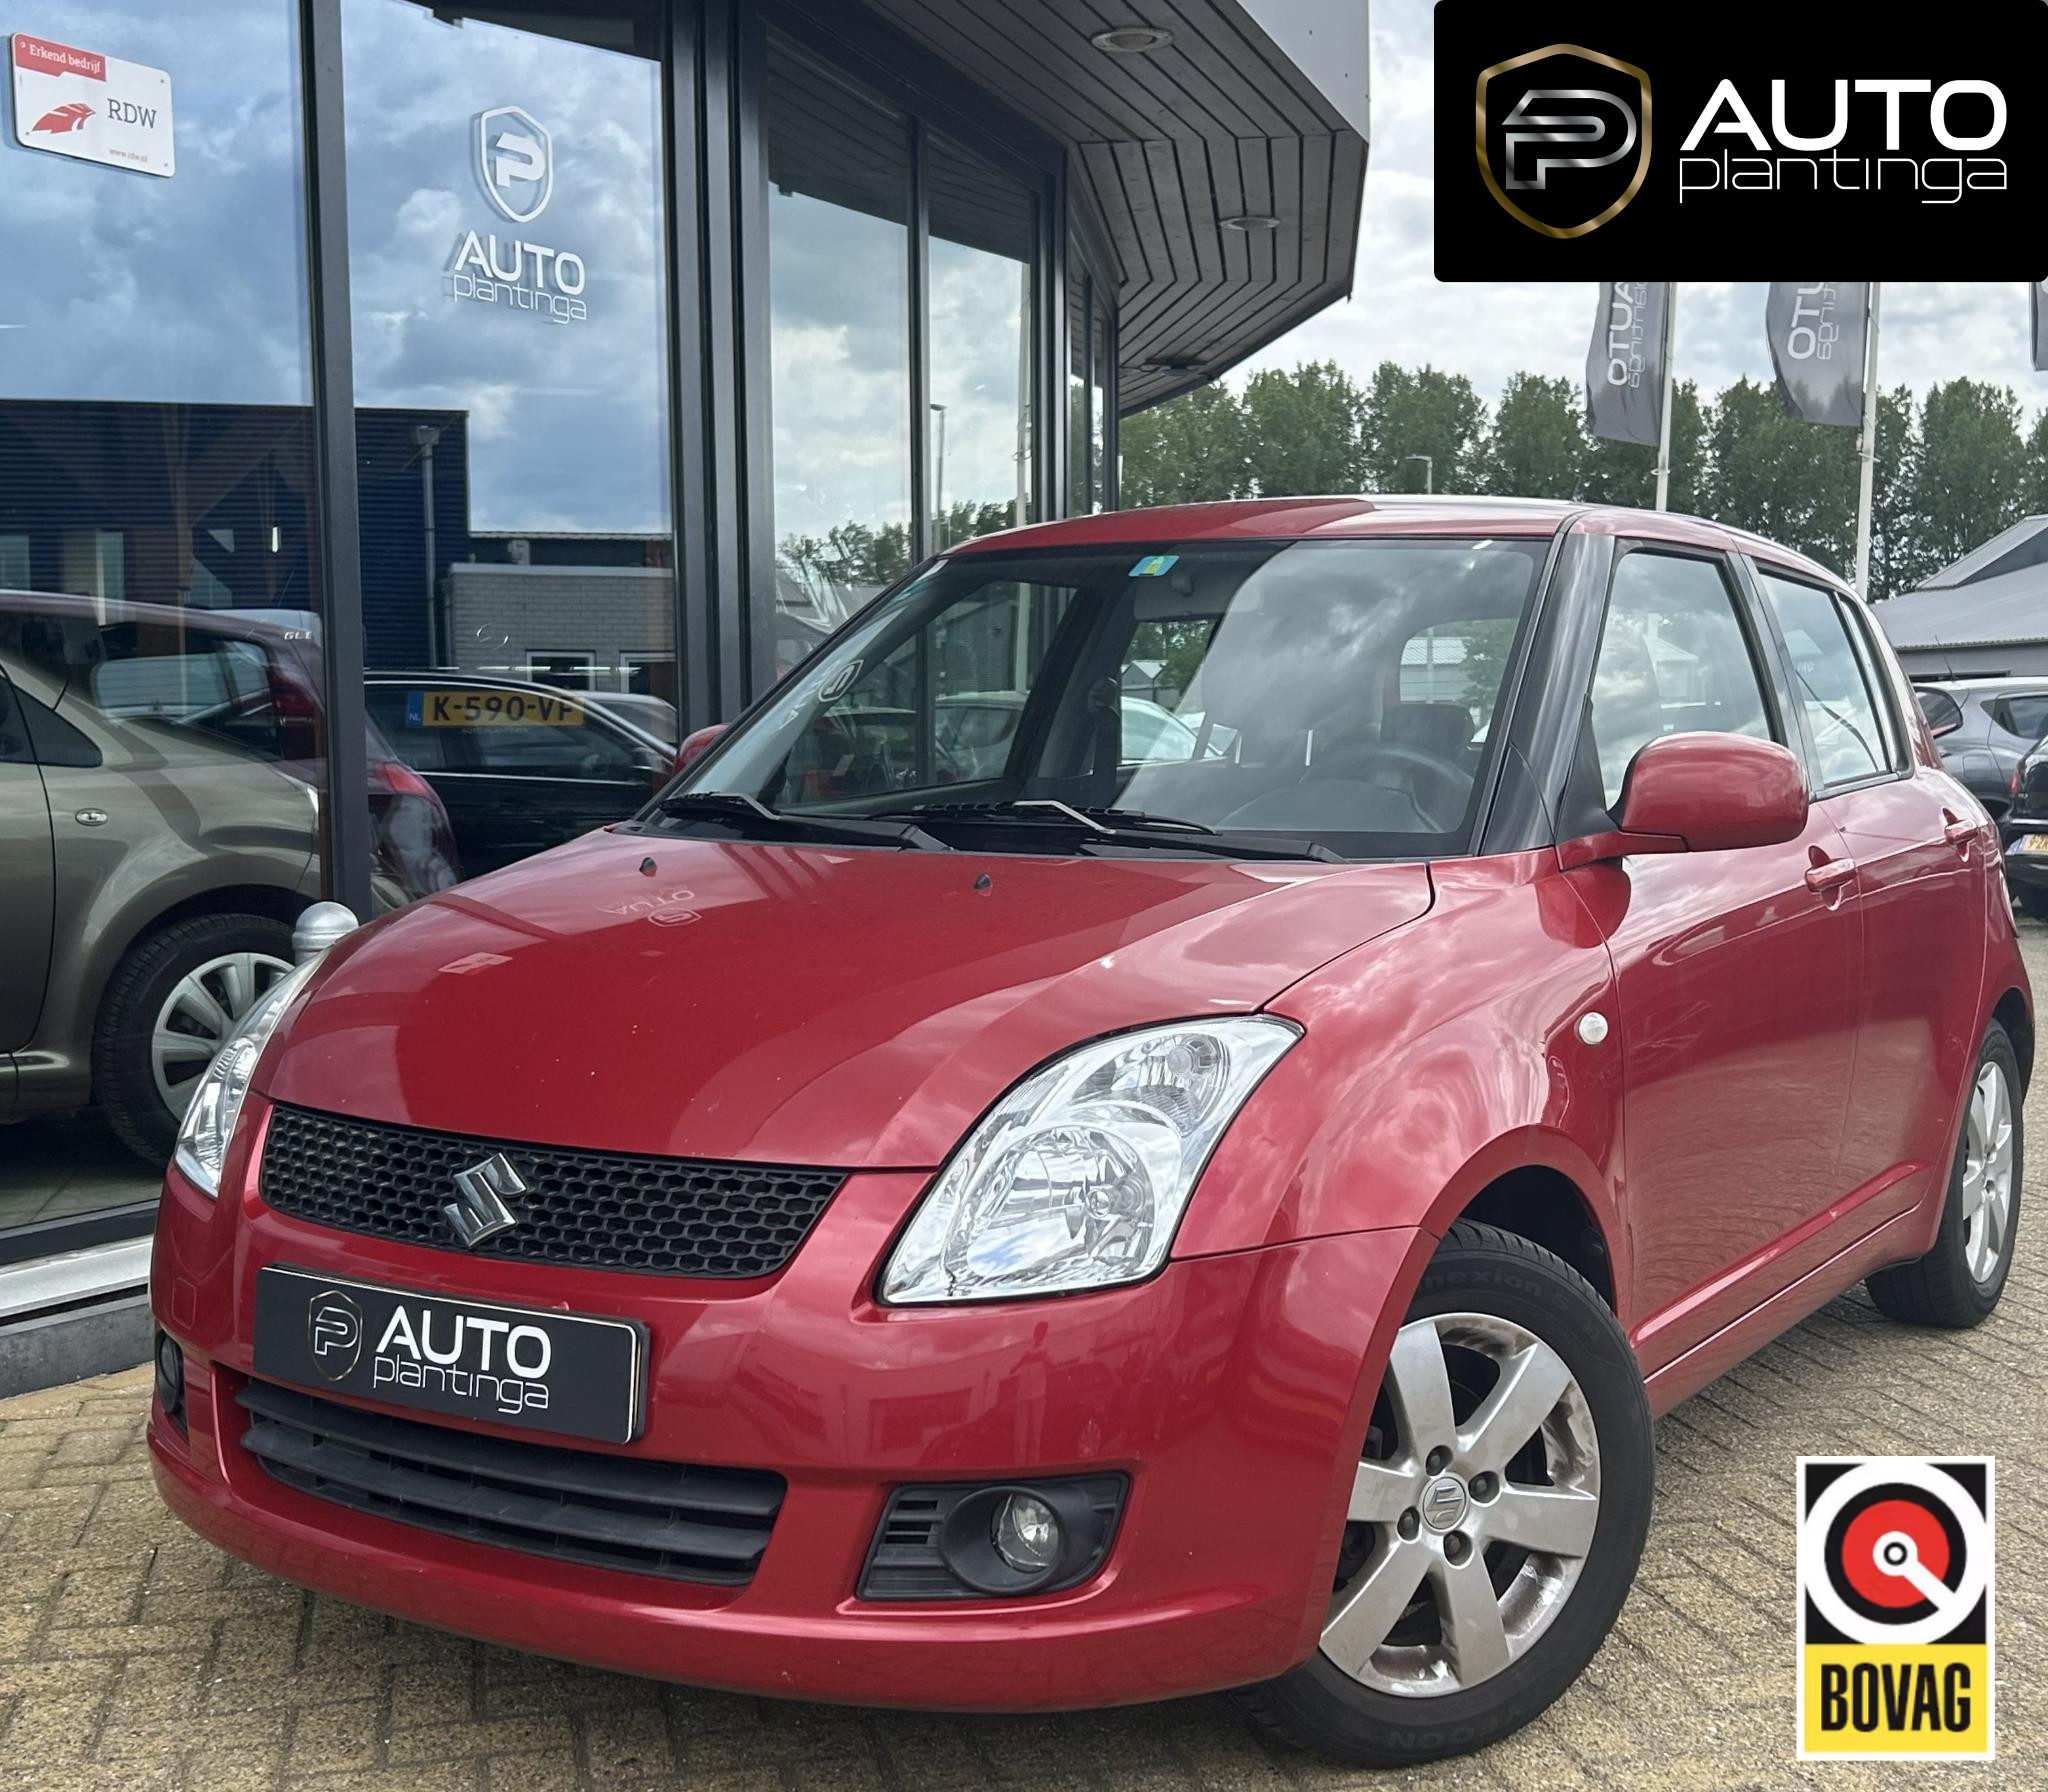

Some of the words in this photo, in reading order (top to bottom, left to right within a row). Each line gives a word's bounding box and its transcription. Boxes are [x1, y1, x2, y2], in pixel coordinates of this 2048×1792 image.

[29, 44, 67, 64] Erkend
[68, 53, 102, 74] bedrijf
[107, 97, 157, 129] RDW
[454, 229, 586, 295] AUTO
[453, 272, 587, 325] plantinga
[409, 712, 421, 721] NL
[1422, 1268, 1543, 1298] nexion
[376, 1305, 551, 1379] AUTO
[373, 1353, 549, 1415] plantinga
